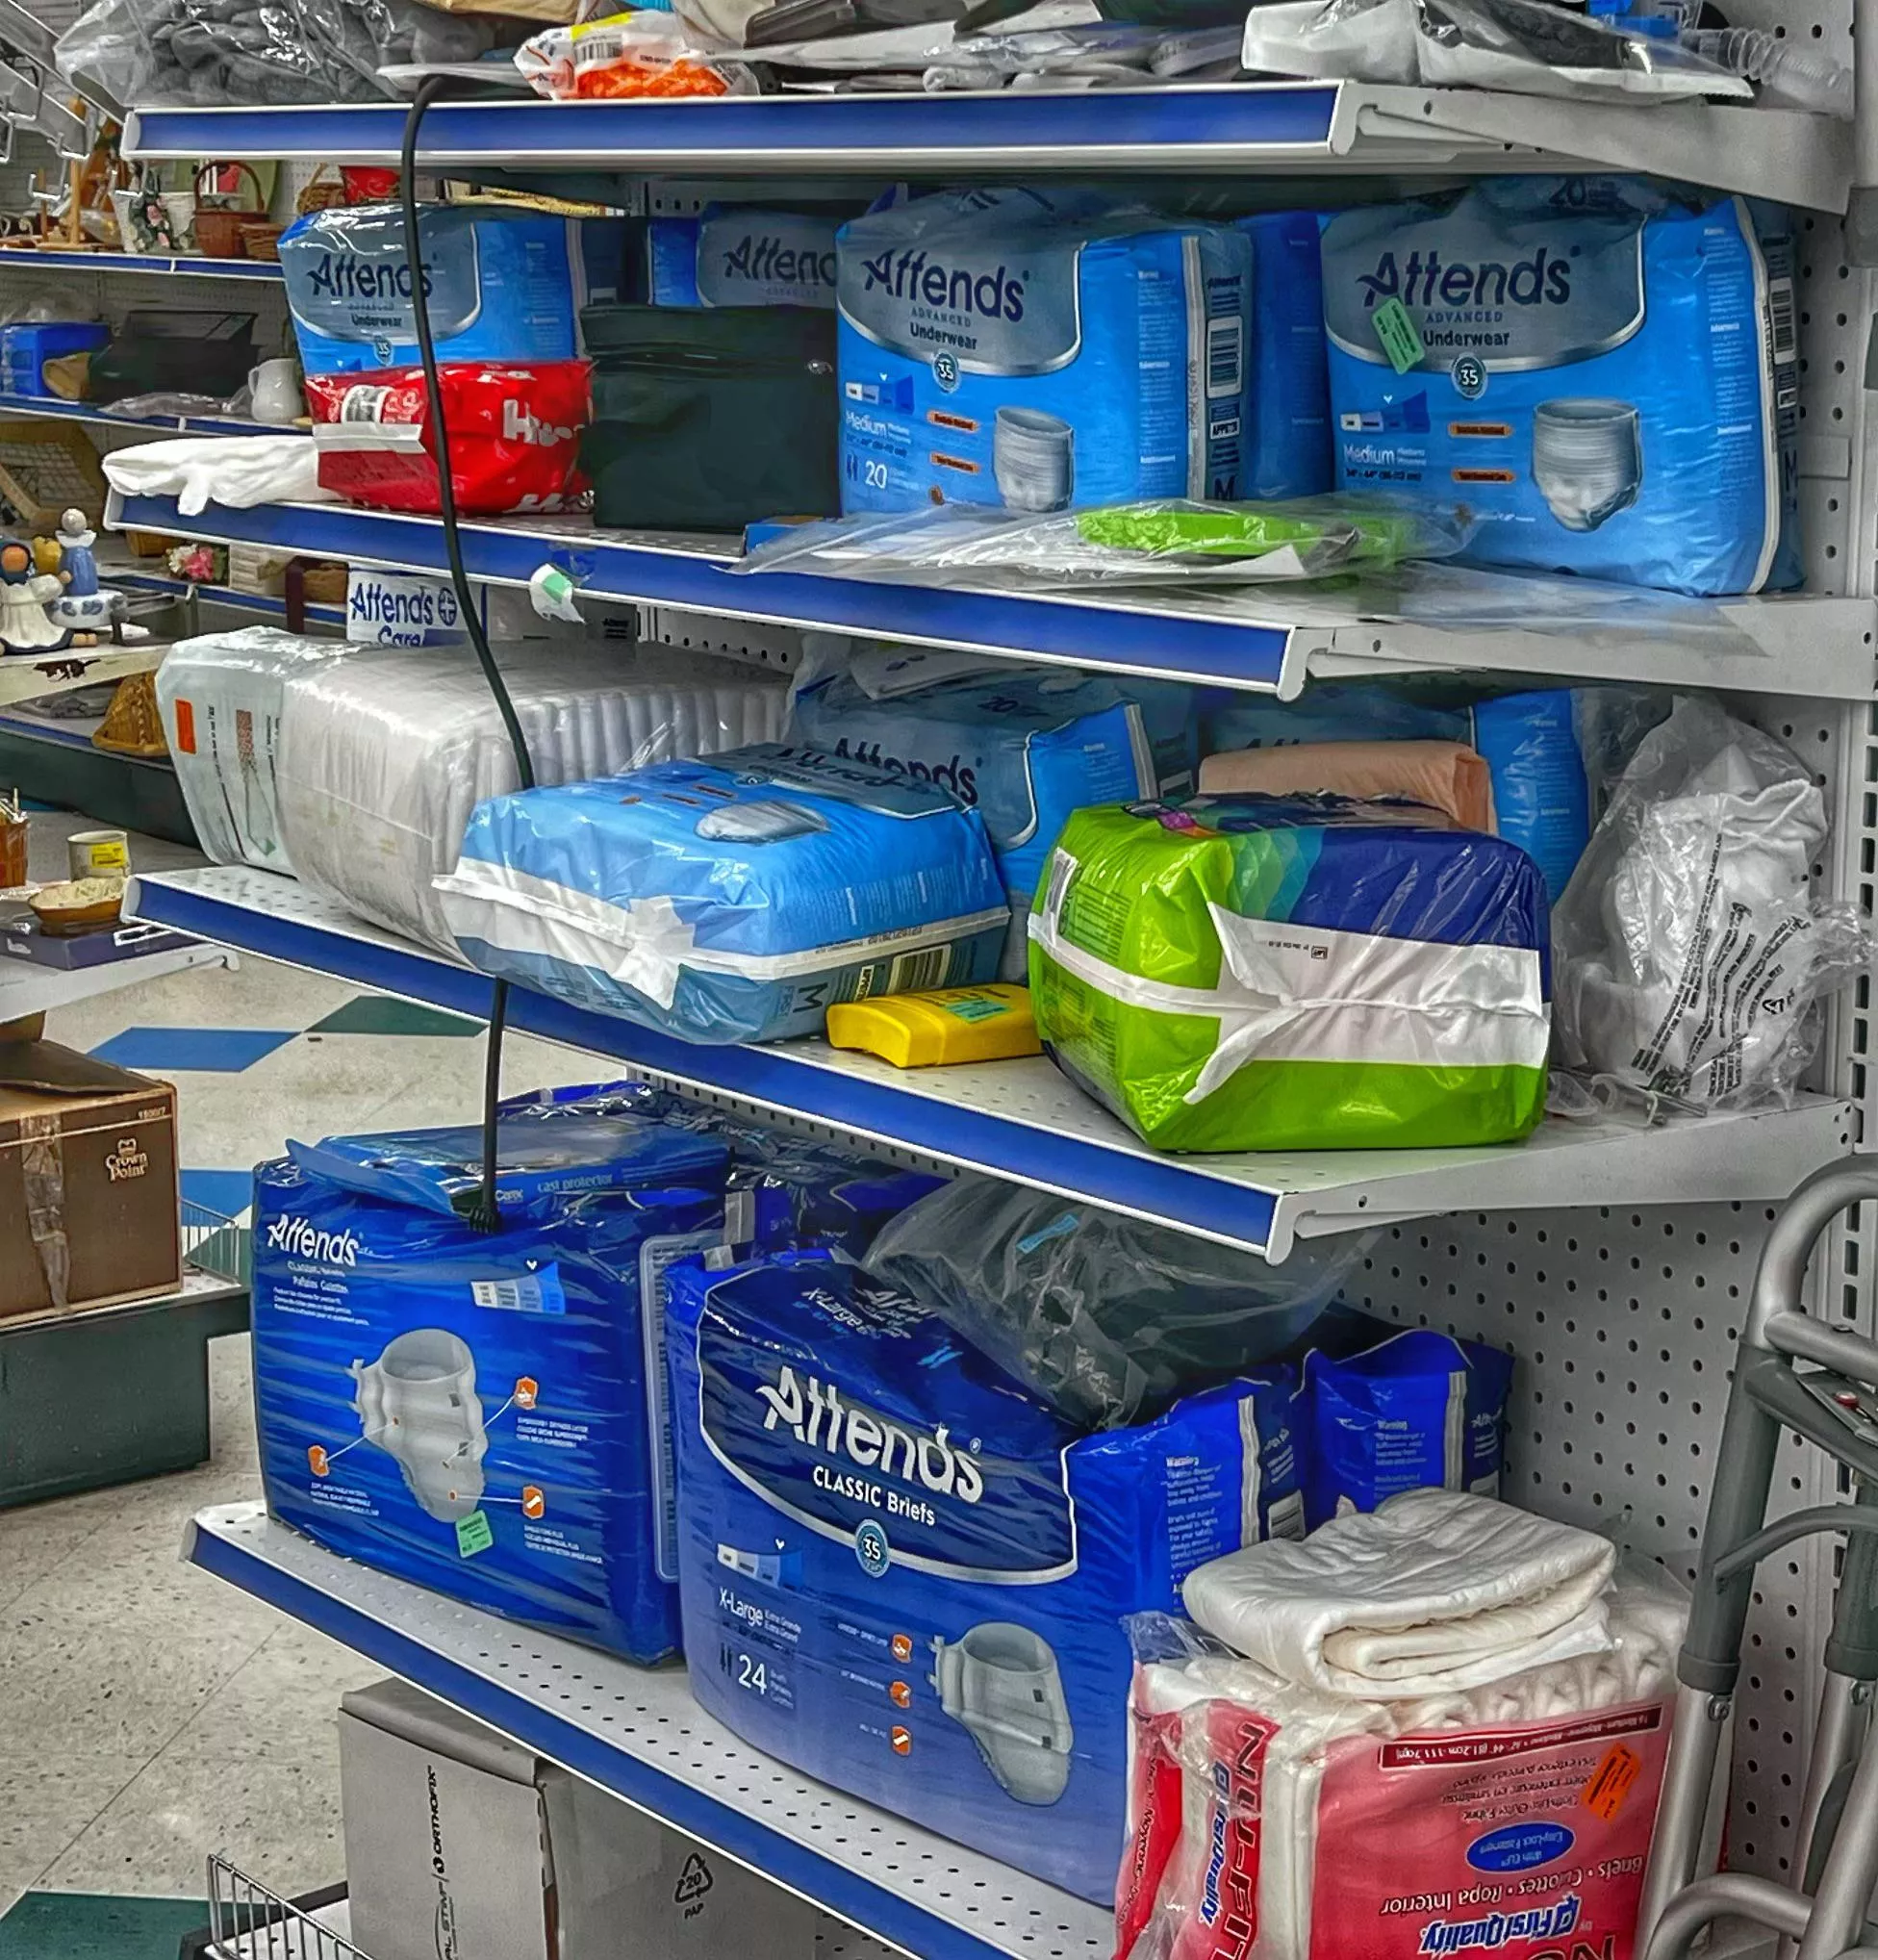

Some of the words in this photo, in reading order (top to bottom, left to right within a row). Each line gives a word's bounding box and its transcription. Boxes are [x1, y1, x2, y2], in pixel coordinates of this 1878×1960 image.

[723, 235, 835, 288] Atten
[861, 248, 1025, 323] Attends
[1356, 244, 1572, 308] Attends
[1426, 311, 1504, 324] ADVANCED
[909, 321, 978, 350] Underwear
[1423, 330, 1510, 347] Underwear
[1459, 369, 1479, 386] 35
[1343, 443, 1396, 466] Medium
[865, 460, 888, 489] 20
[350, 582, 433, 624] Attends
[106, 1152, 148, 1170] Crown
[110, 1163, 146, 1182] Point
[562, 1174, 613, 1191] protector
[266, 1213, 360, 1267] Attends
[755, 1365, 984, 1504] Attends
[813, 1465, 882, 1507] CLASSIC
[886, 1493, 936, 1526] Briefs
[863, 1538, 881, 1561] 35
[719, 1587, 765, 1628] X-Large
[737, 1654, 769, 1696] 24
[1598, 1857, 1643, 1876] Briefs
[686, 1871, 702, 1890] 20
[1381, 1894, 1451, 1915] Interior
[1459, 1883, 1503, 1905] Ropa
[684, 1902, 704, 1920] PAP
[1419, 1908, 1553, 1955] FirstQuality
